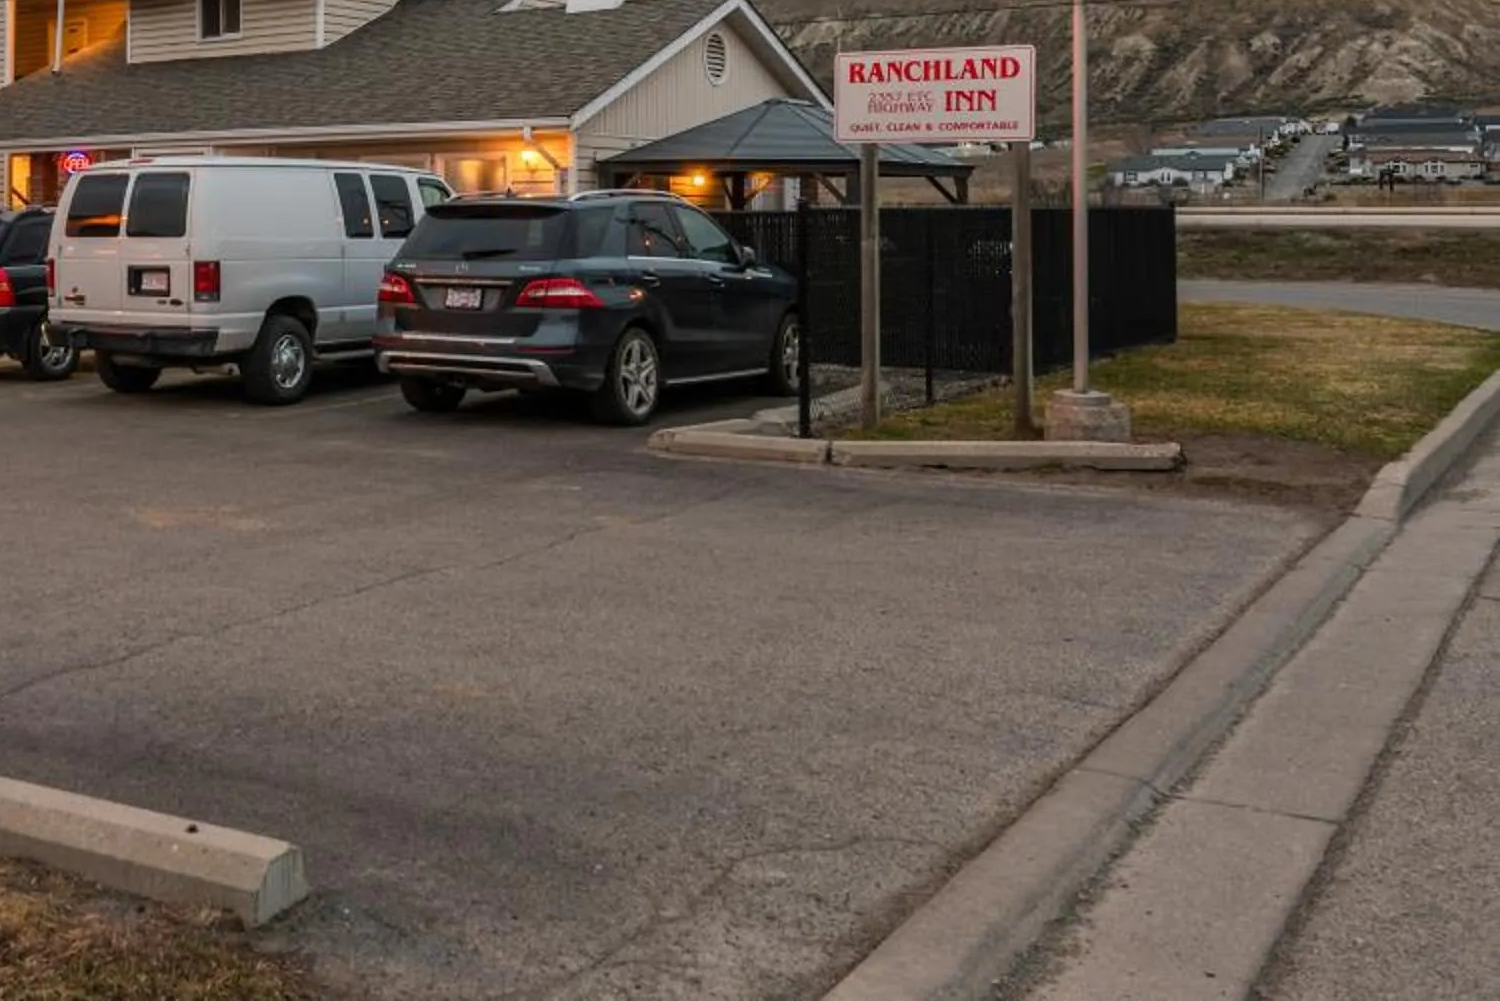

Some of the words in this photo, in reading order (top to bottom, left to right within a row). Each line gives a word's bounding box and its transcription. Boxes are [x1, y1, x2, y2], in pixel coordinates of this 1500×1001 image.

[848, 56, 1020, 84] RANCHLAND
[944, 90, 997, 112] INN
[887, 122, 921, 132] CLEAN
